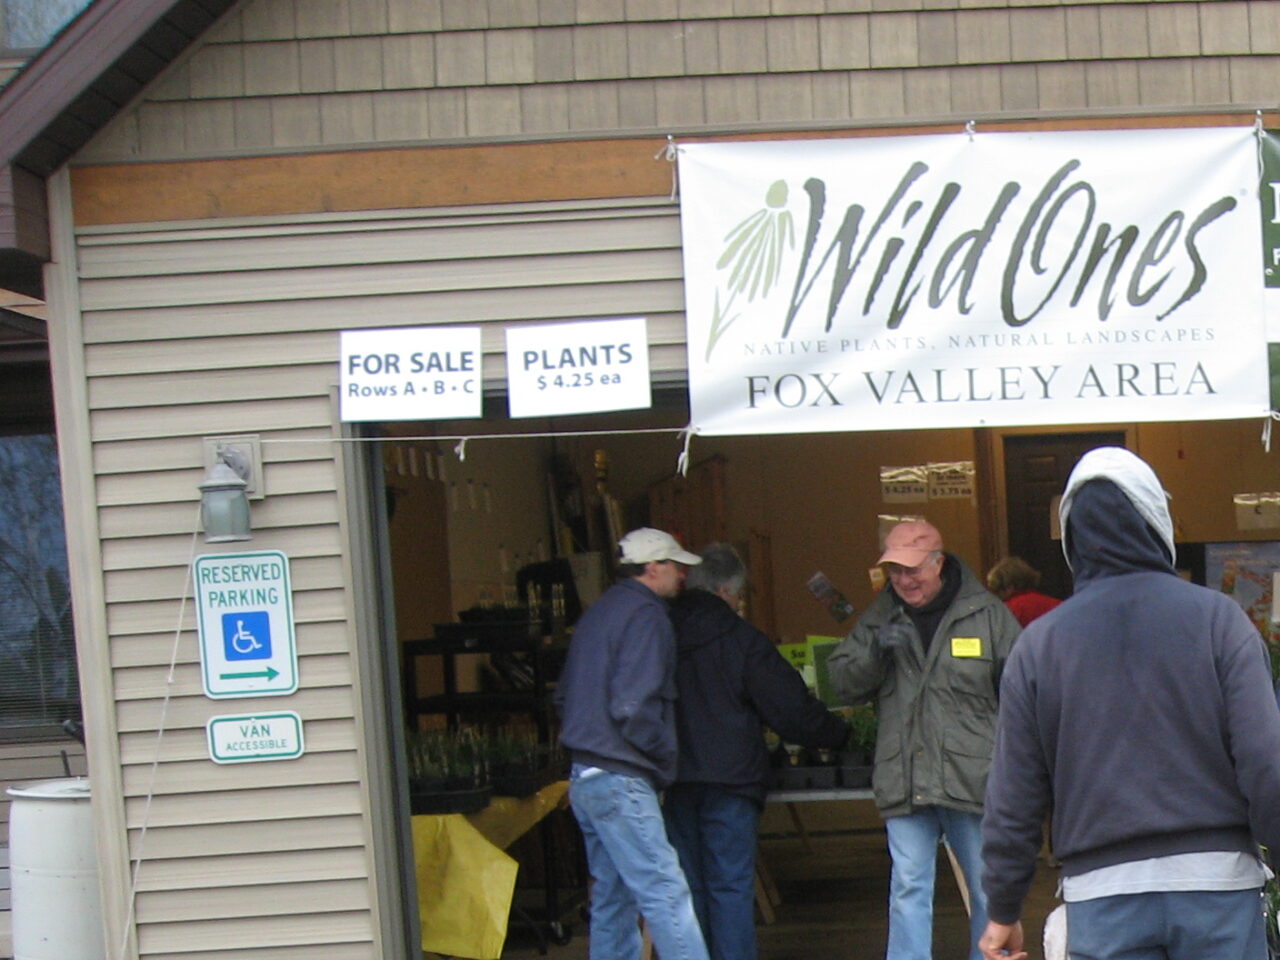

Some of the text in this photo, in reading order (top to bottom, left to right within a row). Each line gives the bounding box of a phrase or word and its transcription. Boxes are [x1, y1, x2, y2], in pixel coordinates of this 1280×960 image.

[781, 158, 1237, 338] Wild Ones
[743, 327, 1216, 356] NATIVE PLANTS, NATURAL LANDSCAPES
[348, 351, 474, 375] FOR SALE
[523, 343, 634, 371] PLANTS
[348, 382, 398, 397] Rows
[403, 380, 416, 395] A
[433, 380, 445, 394] B
[463, 379, 475, 393] C
[553, 372, 594, 389] 4.25
[600, 373, 622, 385] ea
[745, 360, 1218, 409] FOX VALLEY AREA
[200, 562, 281, 585] RESERVED
[208, 587, 279, 608] PARKING
[239, 723, 271, 738] VAN
[226, 738, 288, 752] ACCESSIBLE
